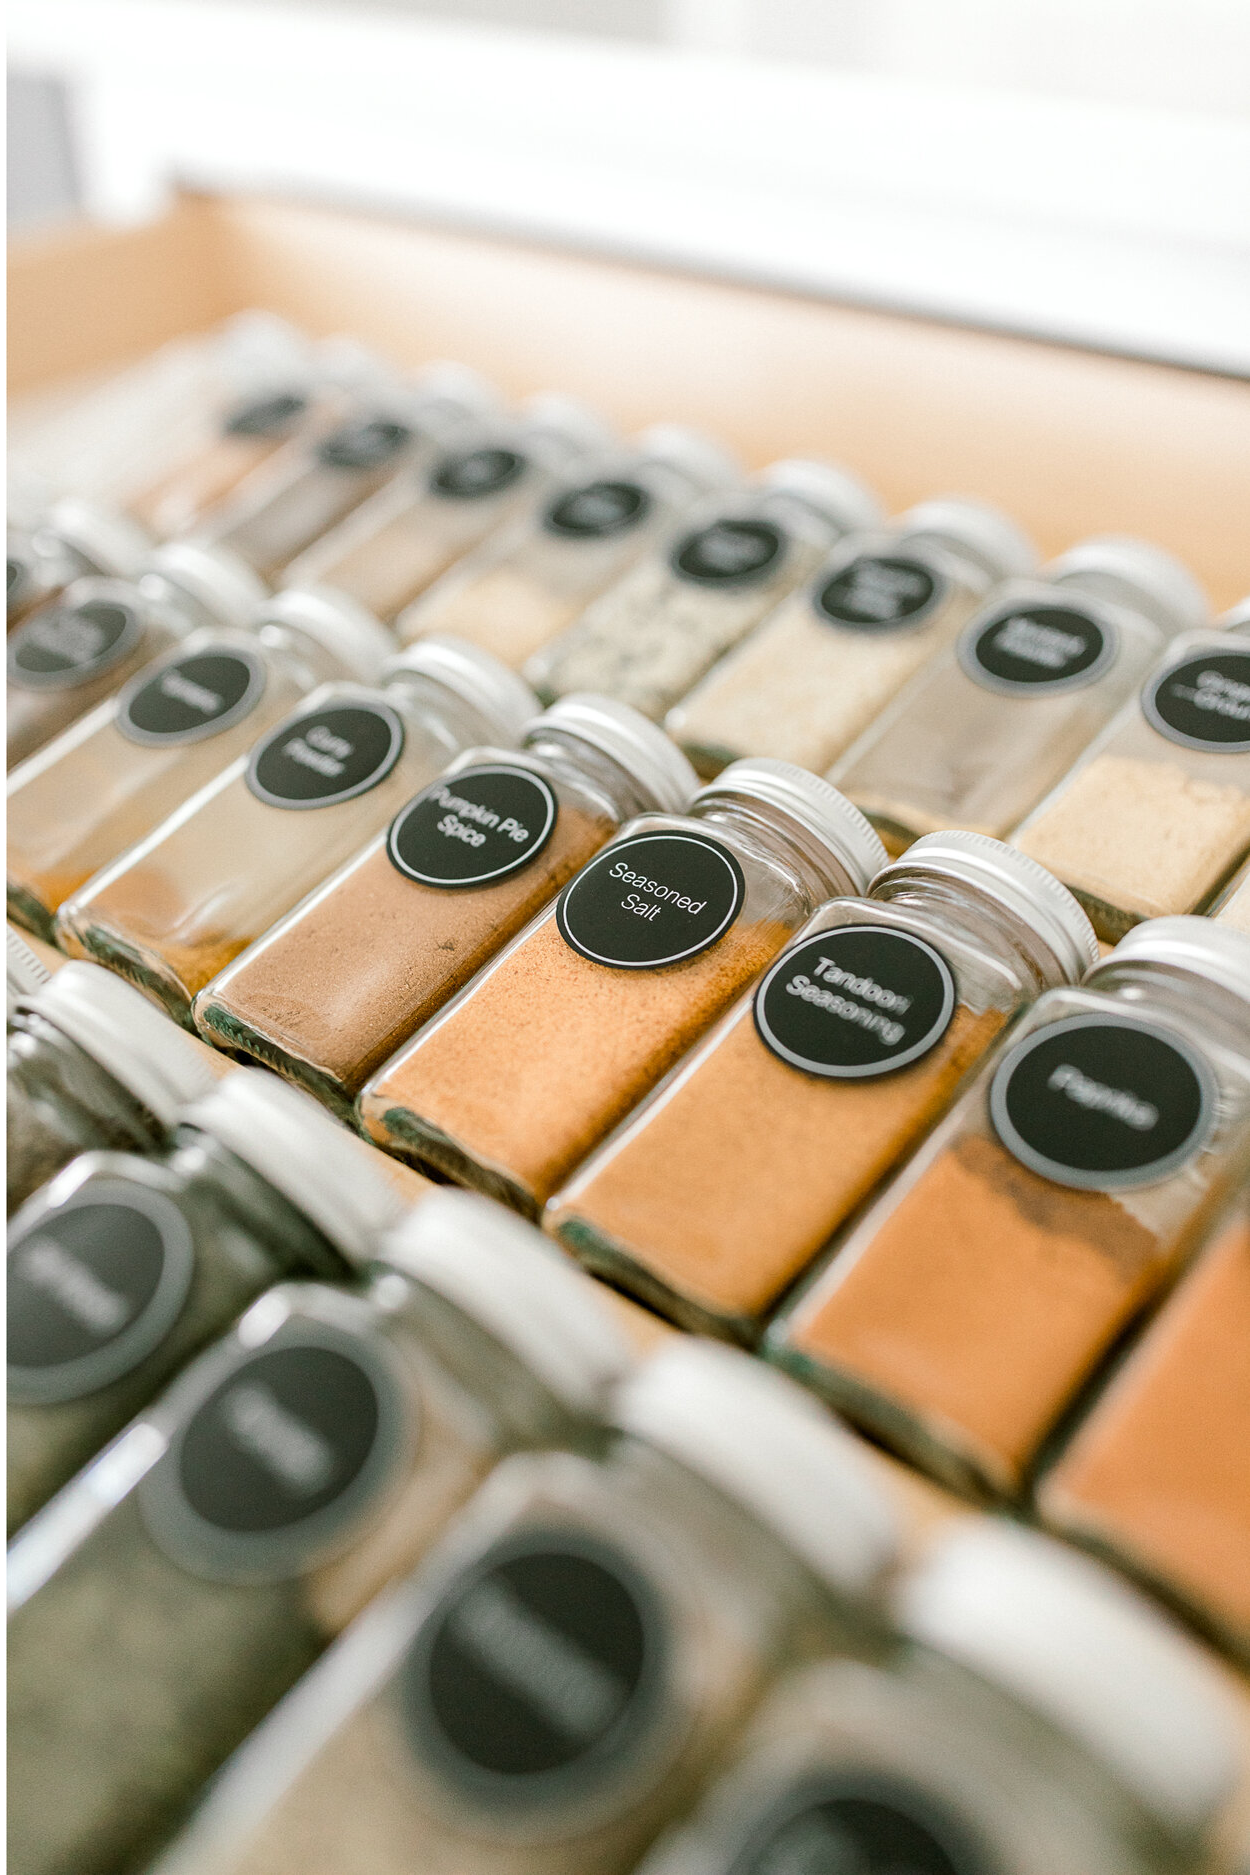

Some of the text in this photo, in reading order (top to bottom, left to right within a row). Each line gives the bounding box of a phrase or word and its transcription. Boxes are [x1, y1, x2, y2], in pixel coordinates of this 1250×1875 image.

[436, 814, 487, 848] Spice
[496, 817, 529, 843] Pie
[609, 862, 707, 915] Seasoned
[620, 894, 662, 922] Salt
[785, 974, 906, 1046] Seasoning
